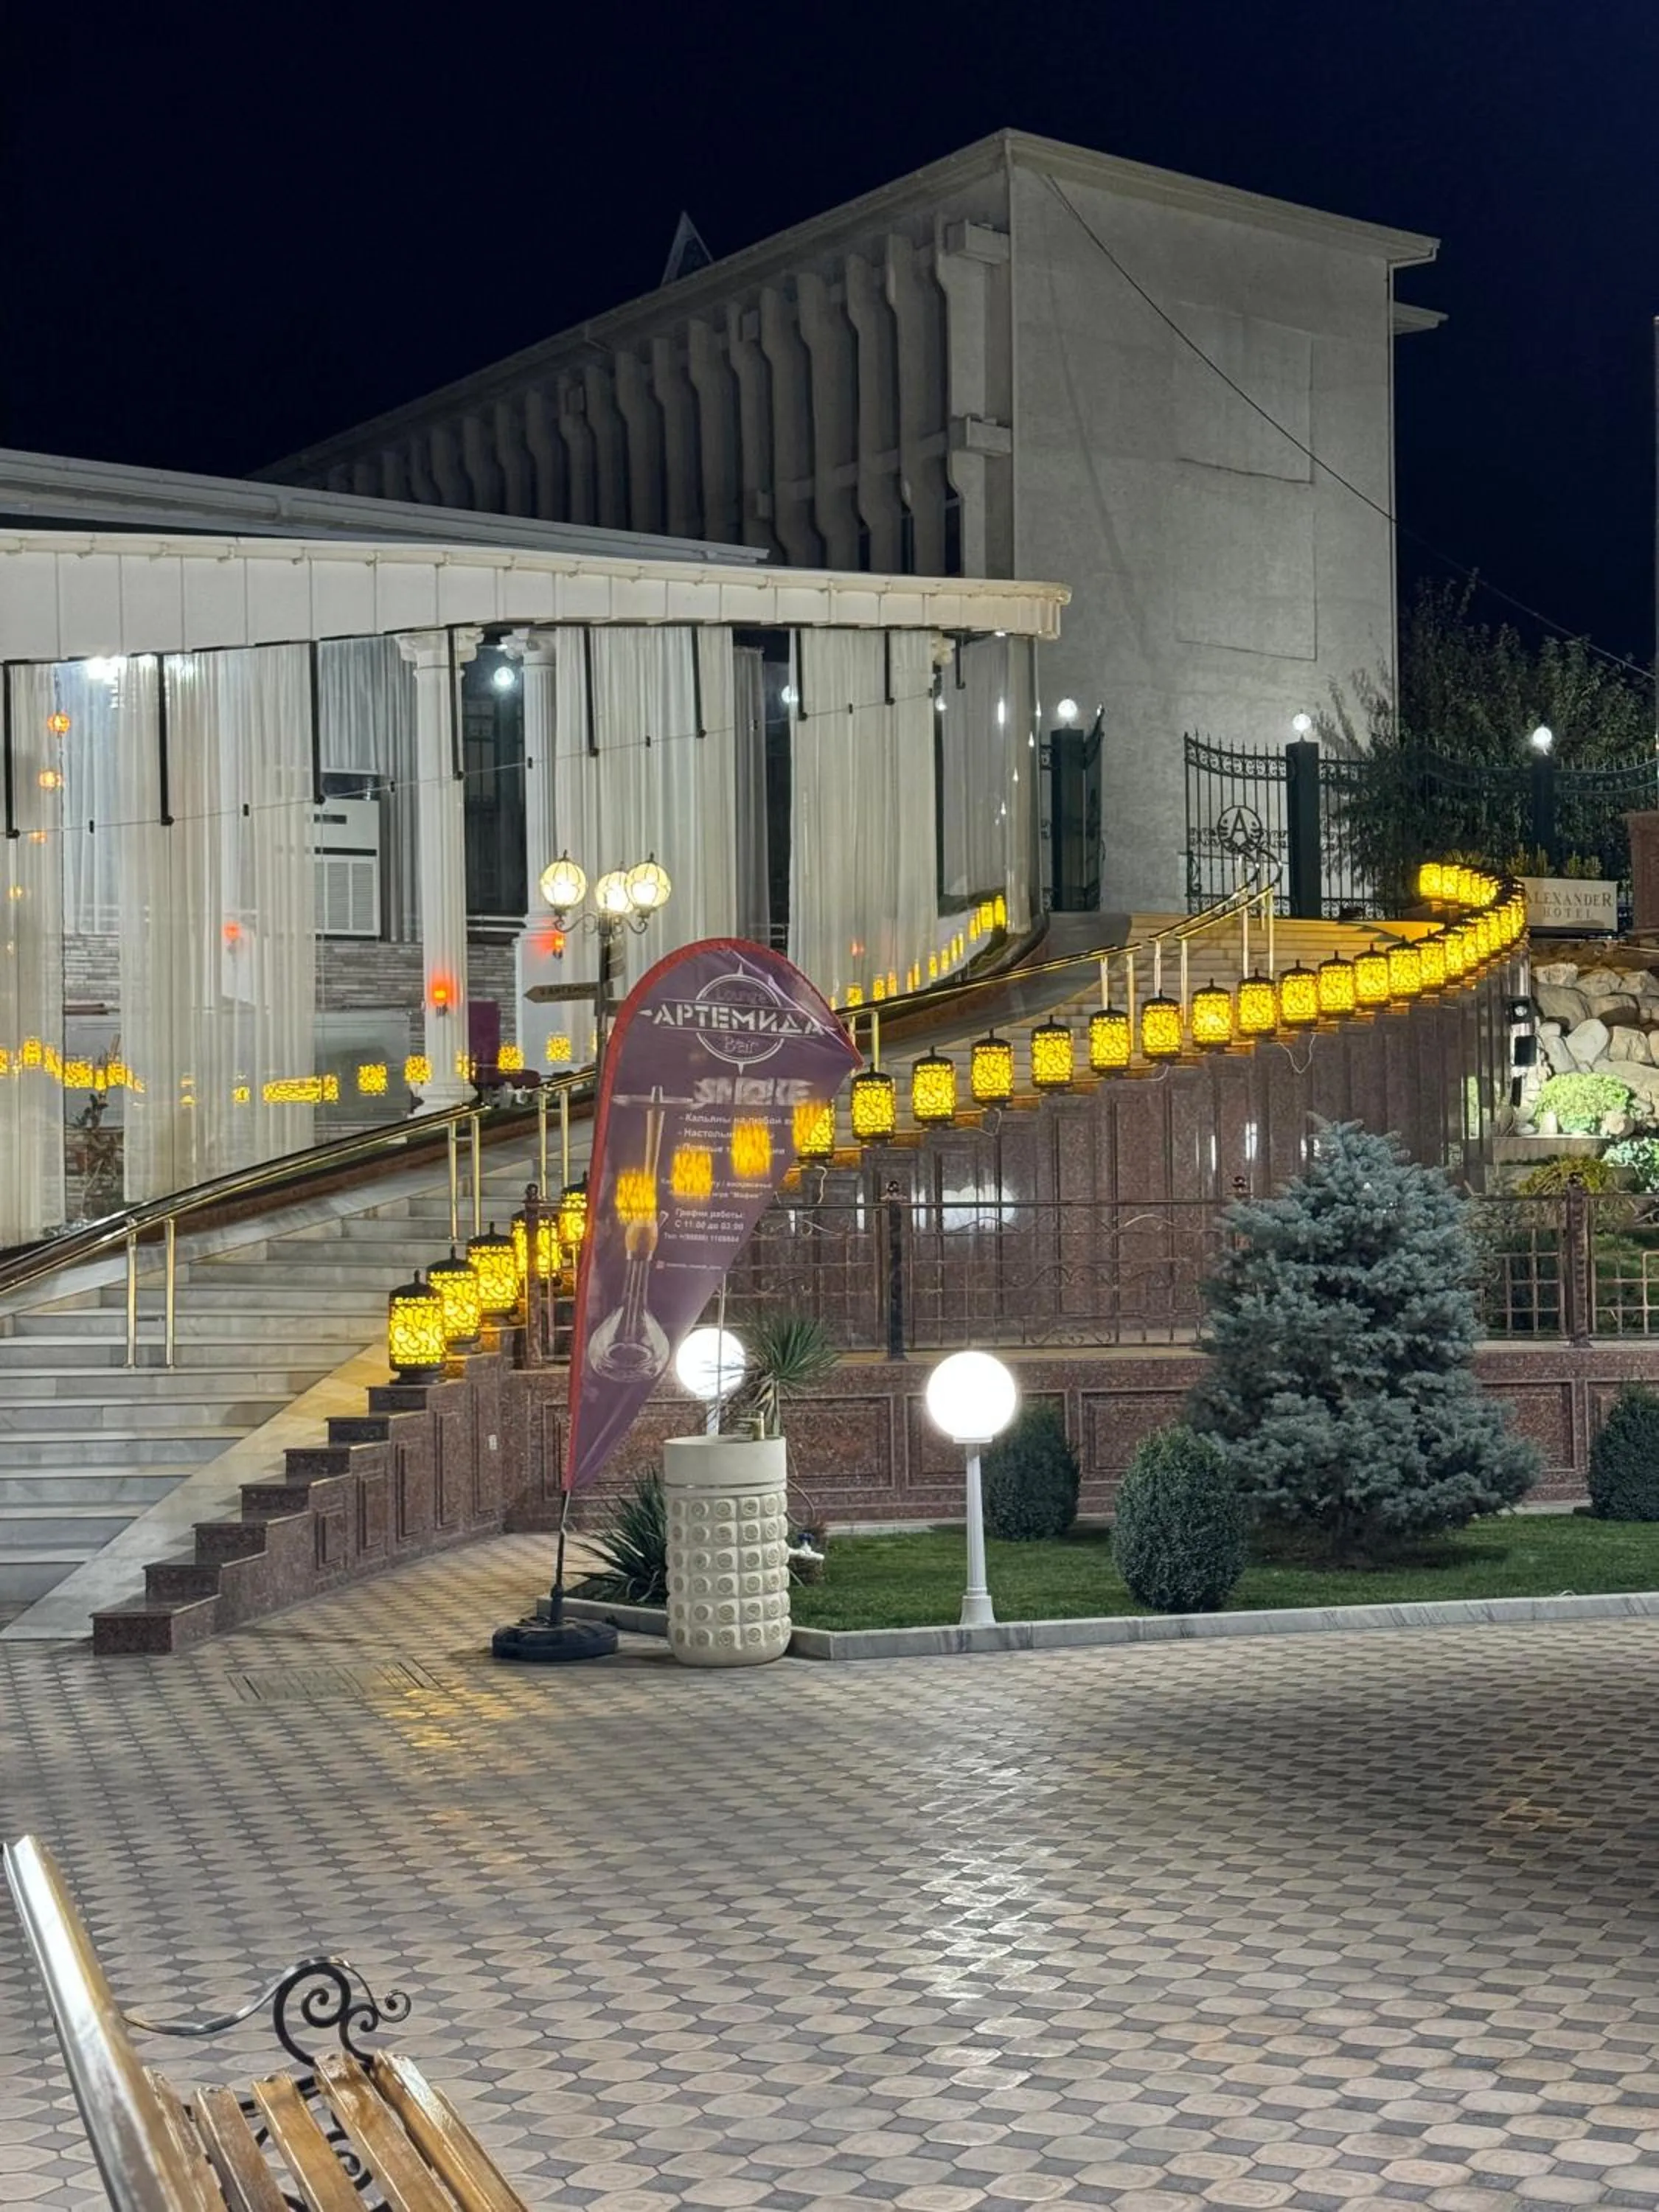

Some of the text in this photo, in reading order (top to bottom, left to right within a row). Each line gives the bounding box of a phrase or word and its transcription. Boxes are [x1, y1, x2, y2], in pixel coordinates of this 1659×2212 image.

[1525, 889, 1613, 907] ALEXANDER
[1543, 907, 1591, 919] HOTEL
[653, 1004, 825, 1034] АРТЕМИДА
